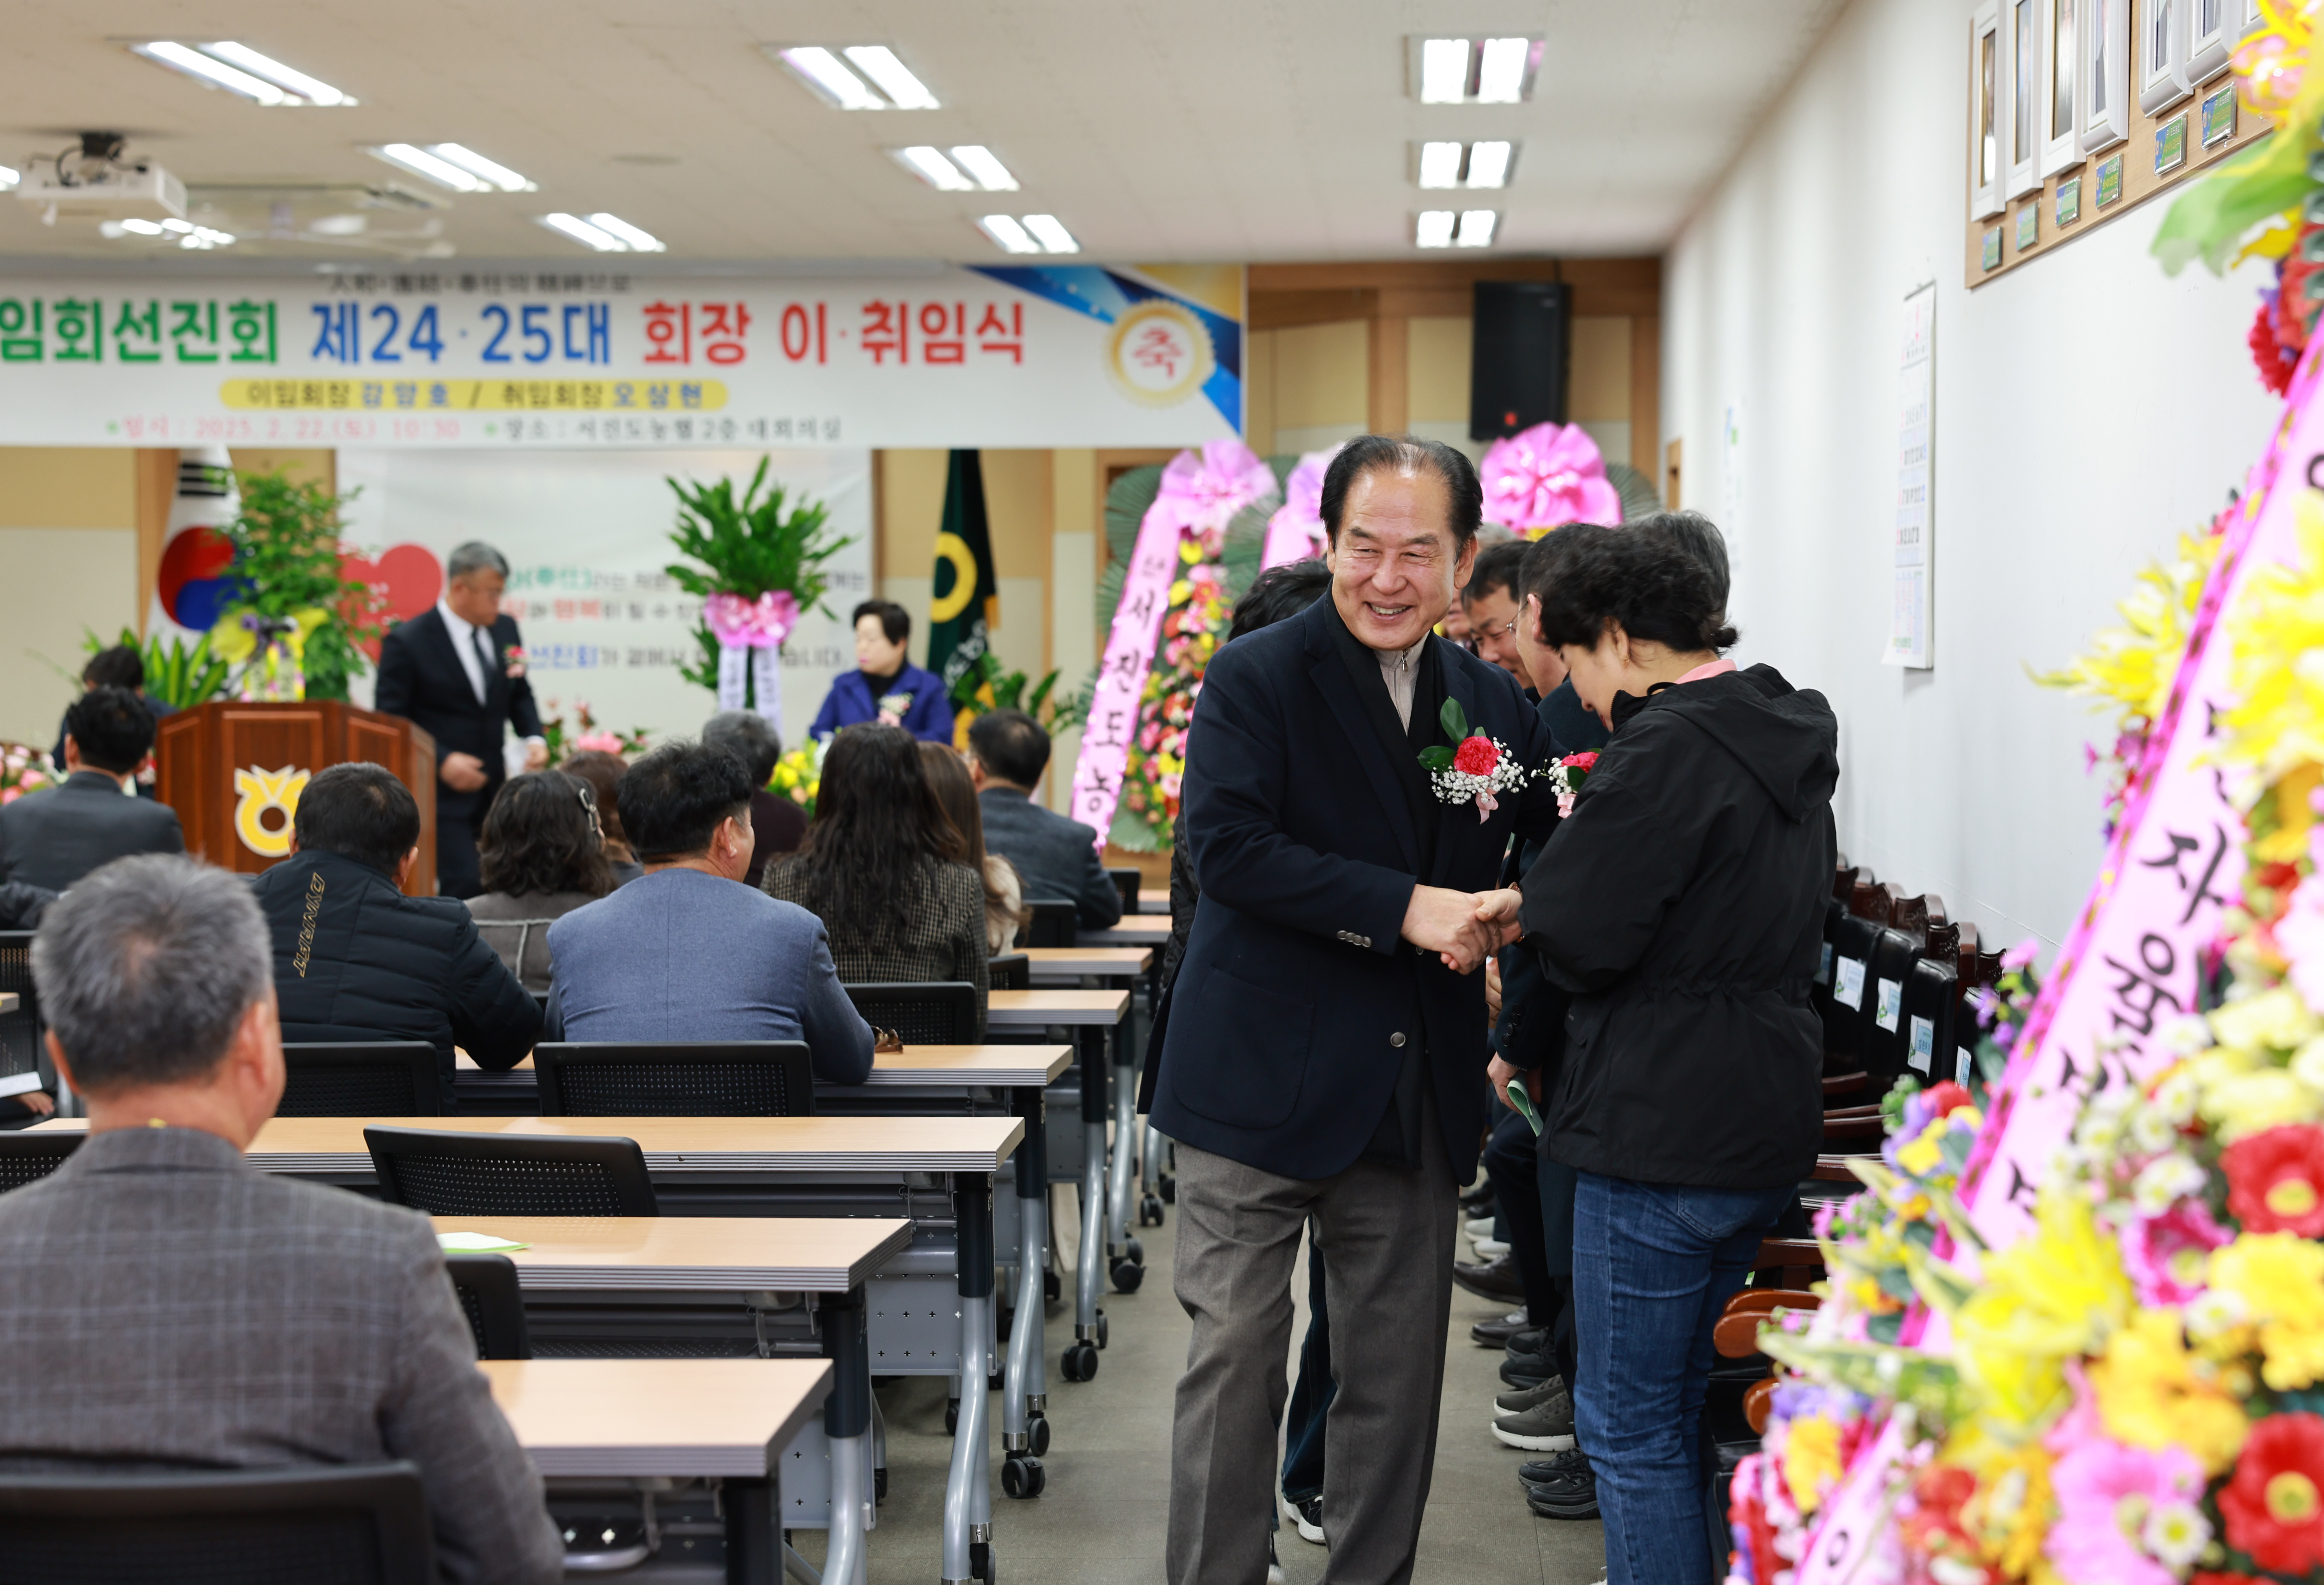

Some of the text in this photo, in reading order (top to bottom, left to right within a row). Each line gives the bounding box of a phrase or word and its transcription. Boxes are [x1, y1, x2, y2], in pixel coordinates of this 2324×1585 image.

[643, 301, 751, 364] 회장
[1134, 327, 1183, 378] 축
[248, 382, 350, 407] 이임회장
[502, 382, 603, 407] 취임회장
[504, 417, 549, 441] 장소
[293, 871, 326, 979] DYNAFIT
